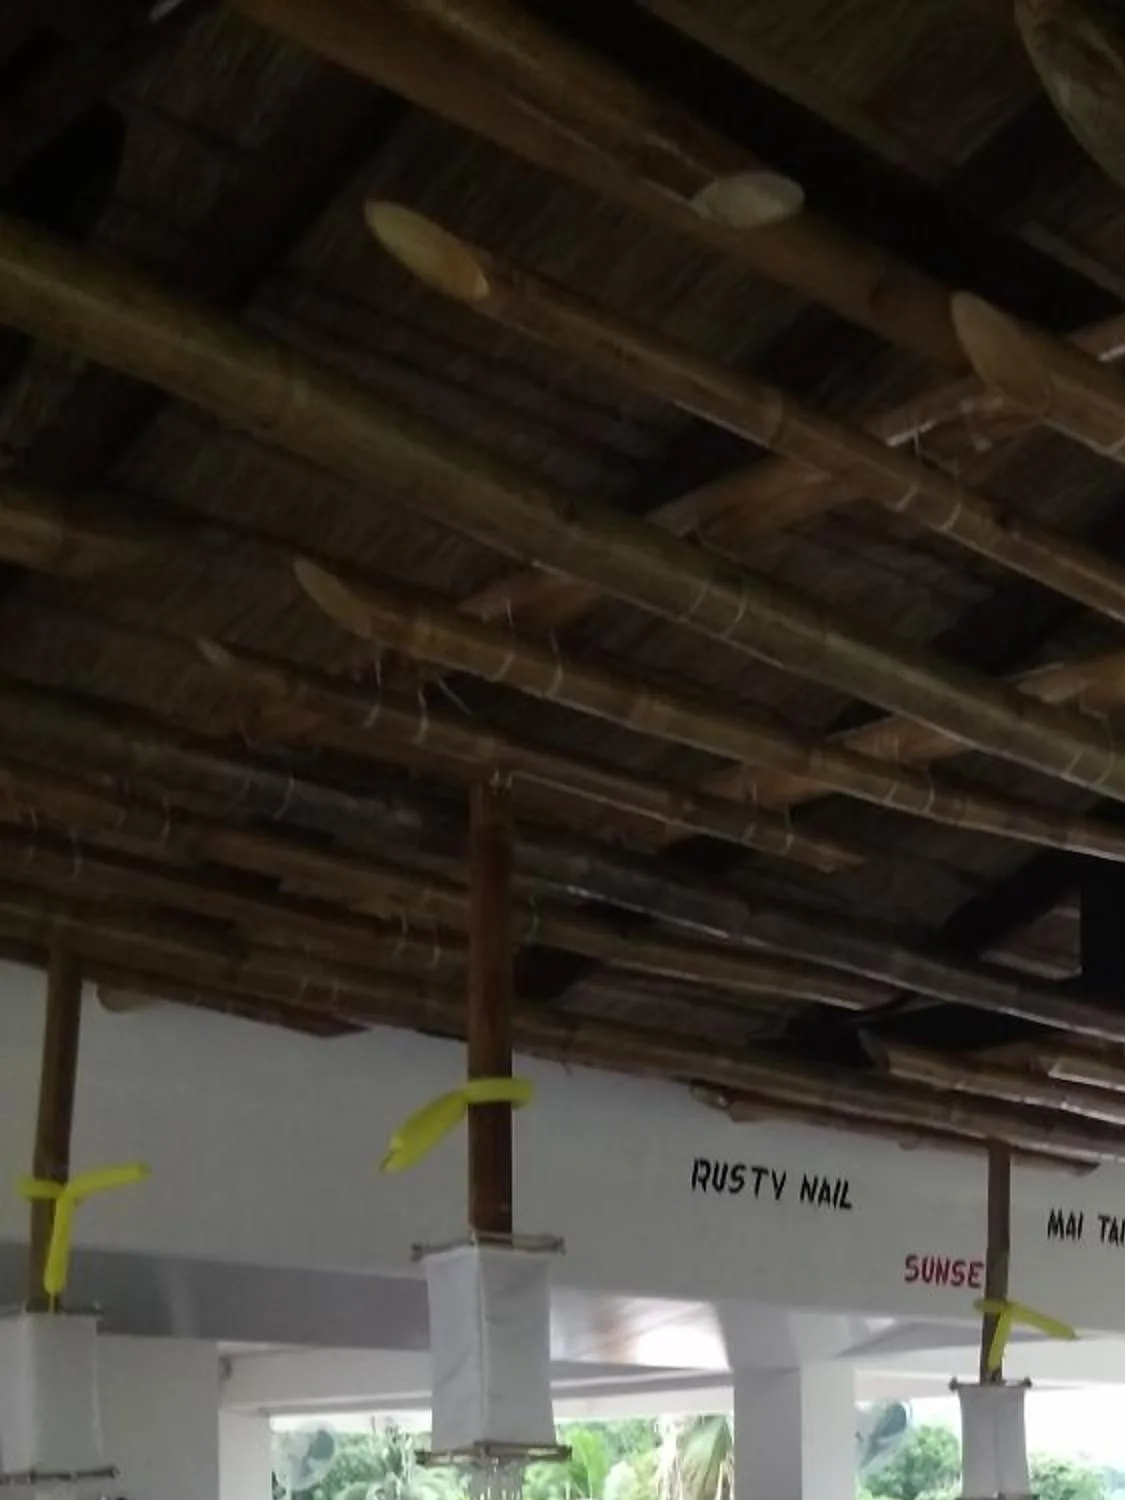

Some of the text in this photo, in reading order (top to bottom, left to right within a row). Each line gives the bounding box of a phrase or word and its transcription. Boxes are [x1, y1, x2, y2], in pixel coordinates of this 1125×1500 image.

[692, 1157, 852, 1209] RUSTY NAIL
[1047, 1207, 1084, 1241] MAI
[904, 1253, 984, 1289] SUNSE
